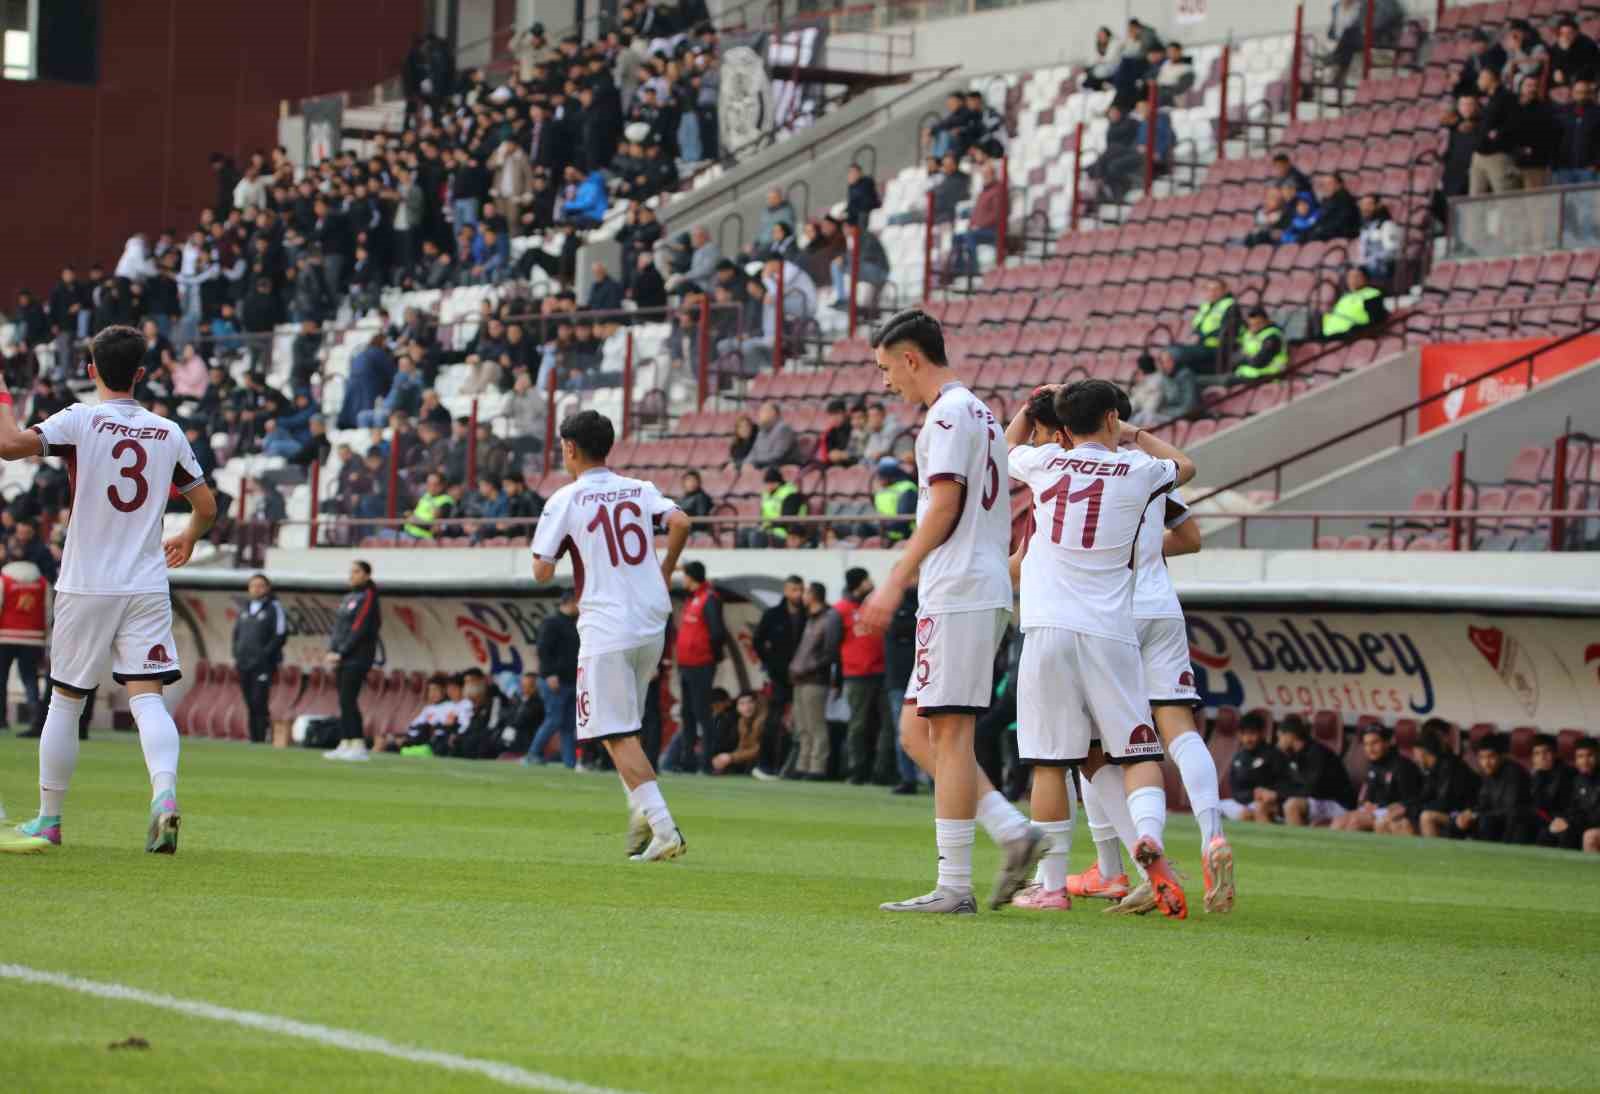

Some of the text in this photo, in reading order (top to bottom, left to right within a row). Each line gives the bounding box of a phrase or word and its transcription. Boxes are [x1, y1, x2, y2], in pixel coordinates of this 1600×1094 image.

[98, 421, 169, 441] PROEM
[107, 438, 148, 512] 3
[1047, 457, 1130, 477] PROEM
[582, 487, 642, 506] PROEM
[1040, 473, 1105, 549] 11
[587, 501, 648, 567] 16
[917, 648, 929, 682] 5
[1257, 676, 1404, 718] Logistics
